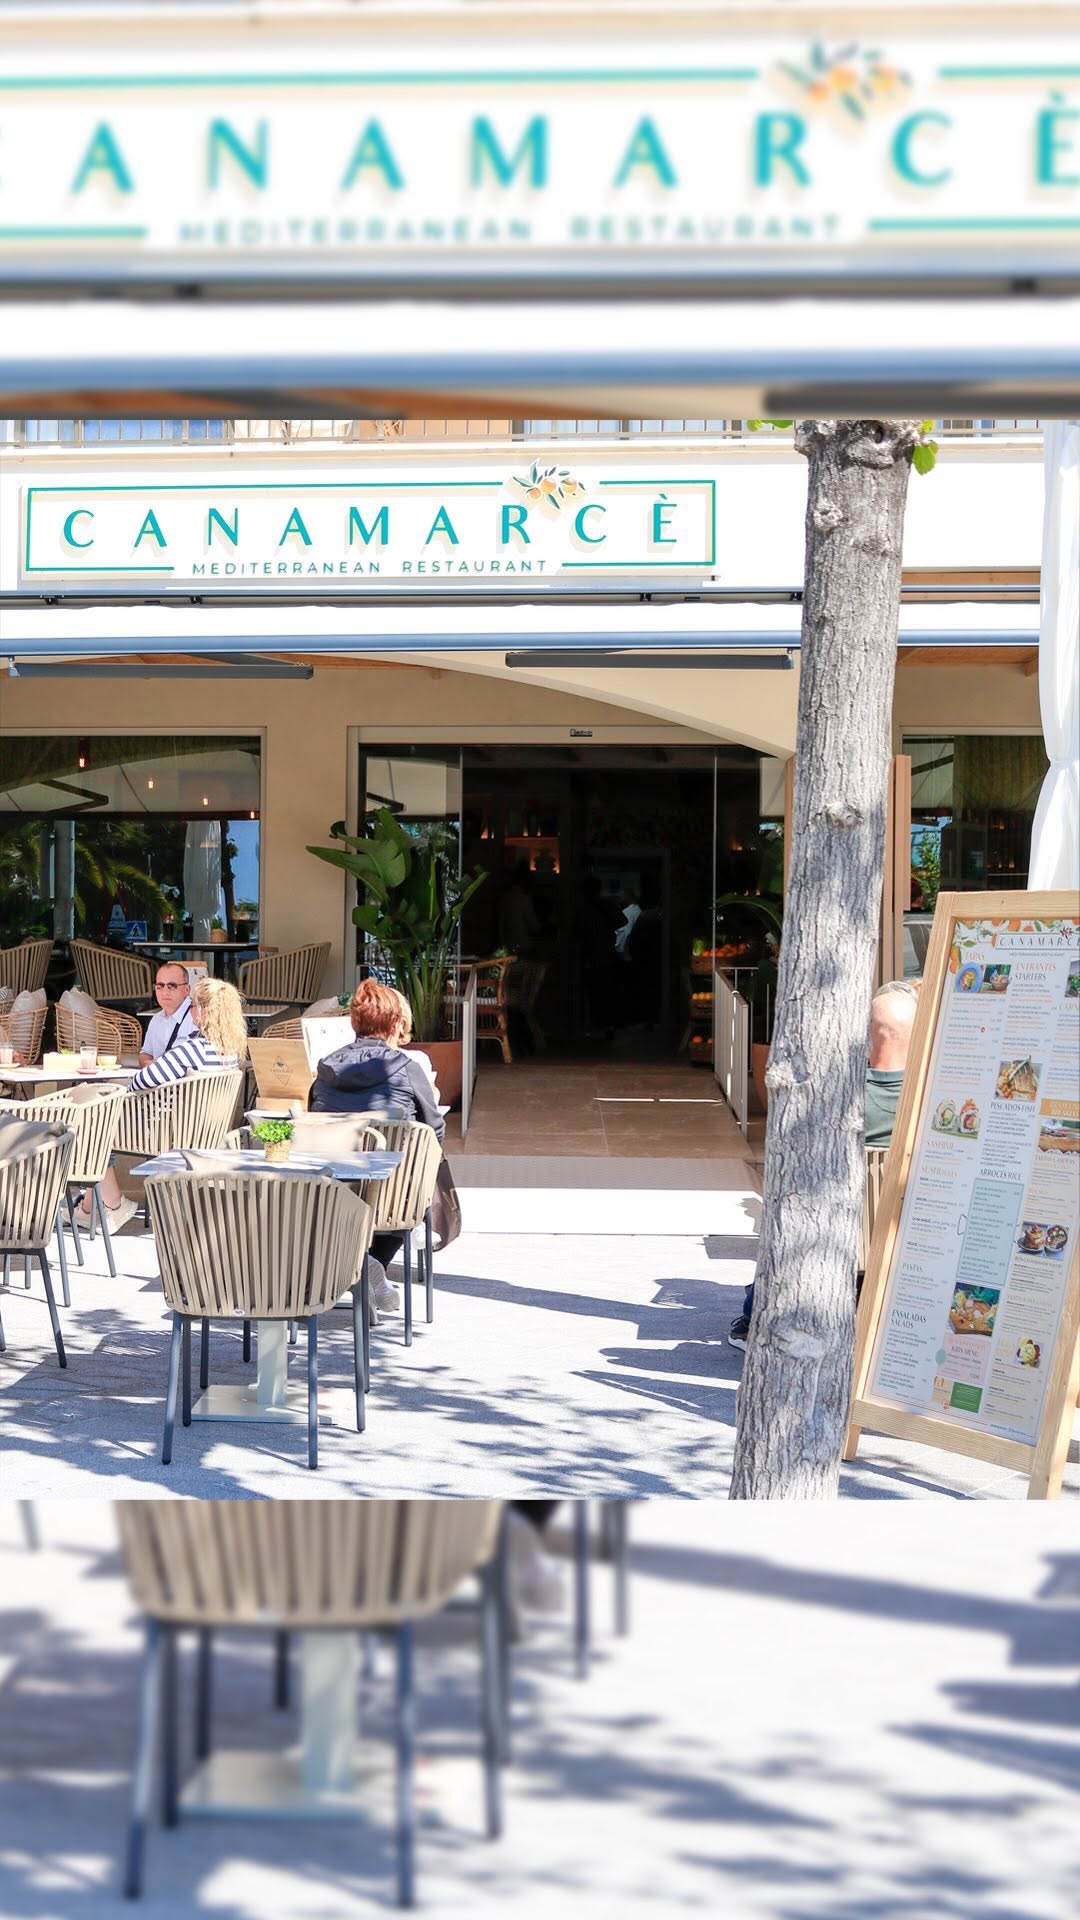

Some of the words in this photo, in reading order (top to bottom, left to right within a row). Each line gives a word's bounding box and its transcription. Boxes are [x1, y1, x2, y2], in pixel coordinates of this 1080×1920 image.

[0, 92, 1080, 196] ANAMARCÈ
[180, 218, 532, 242] MEDITERRANEAN
[571, 215, 840, 239] RESTAURANT
[63, 493, 678, 549] CANAMARCÈ
[192, 561, 381, 575] MEDITERRANEAN
[402, 559, 547, 573] RESTAURANT
[991, 1101, 1020, 1112] PESCADOS
[979, 1168, 1007, 1179] ARROCES
[1007, 1171, 1023, 1181] RICE
[890, 1318, 914, 1329] SALADS
[891, 1309, 927, 1323] ENSALADAS
